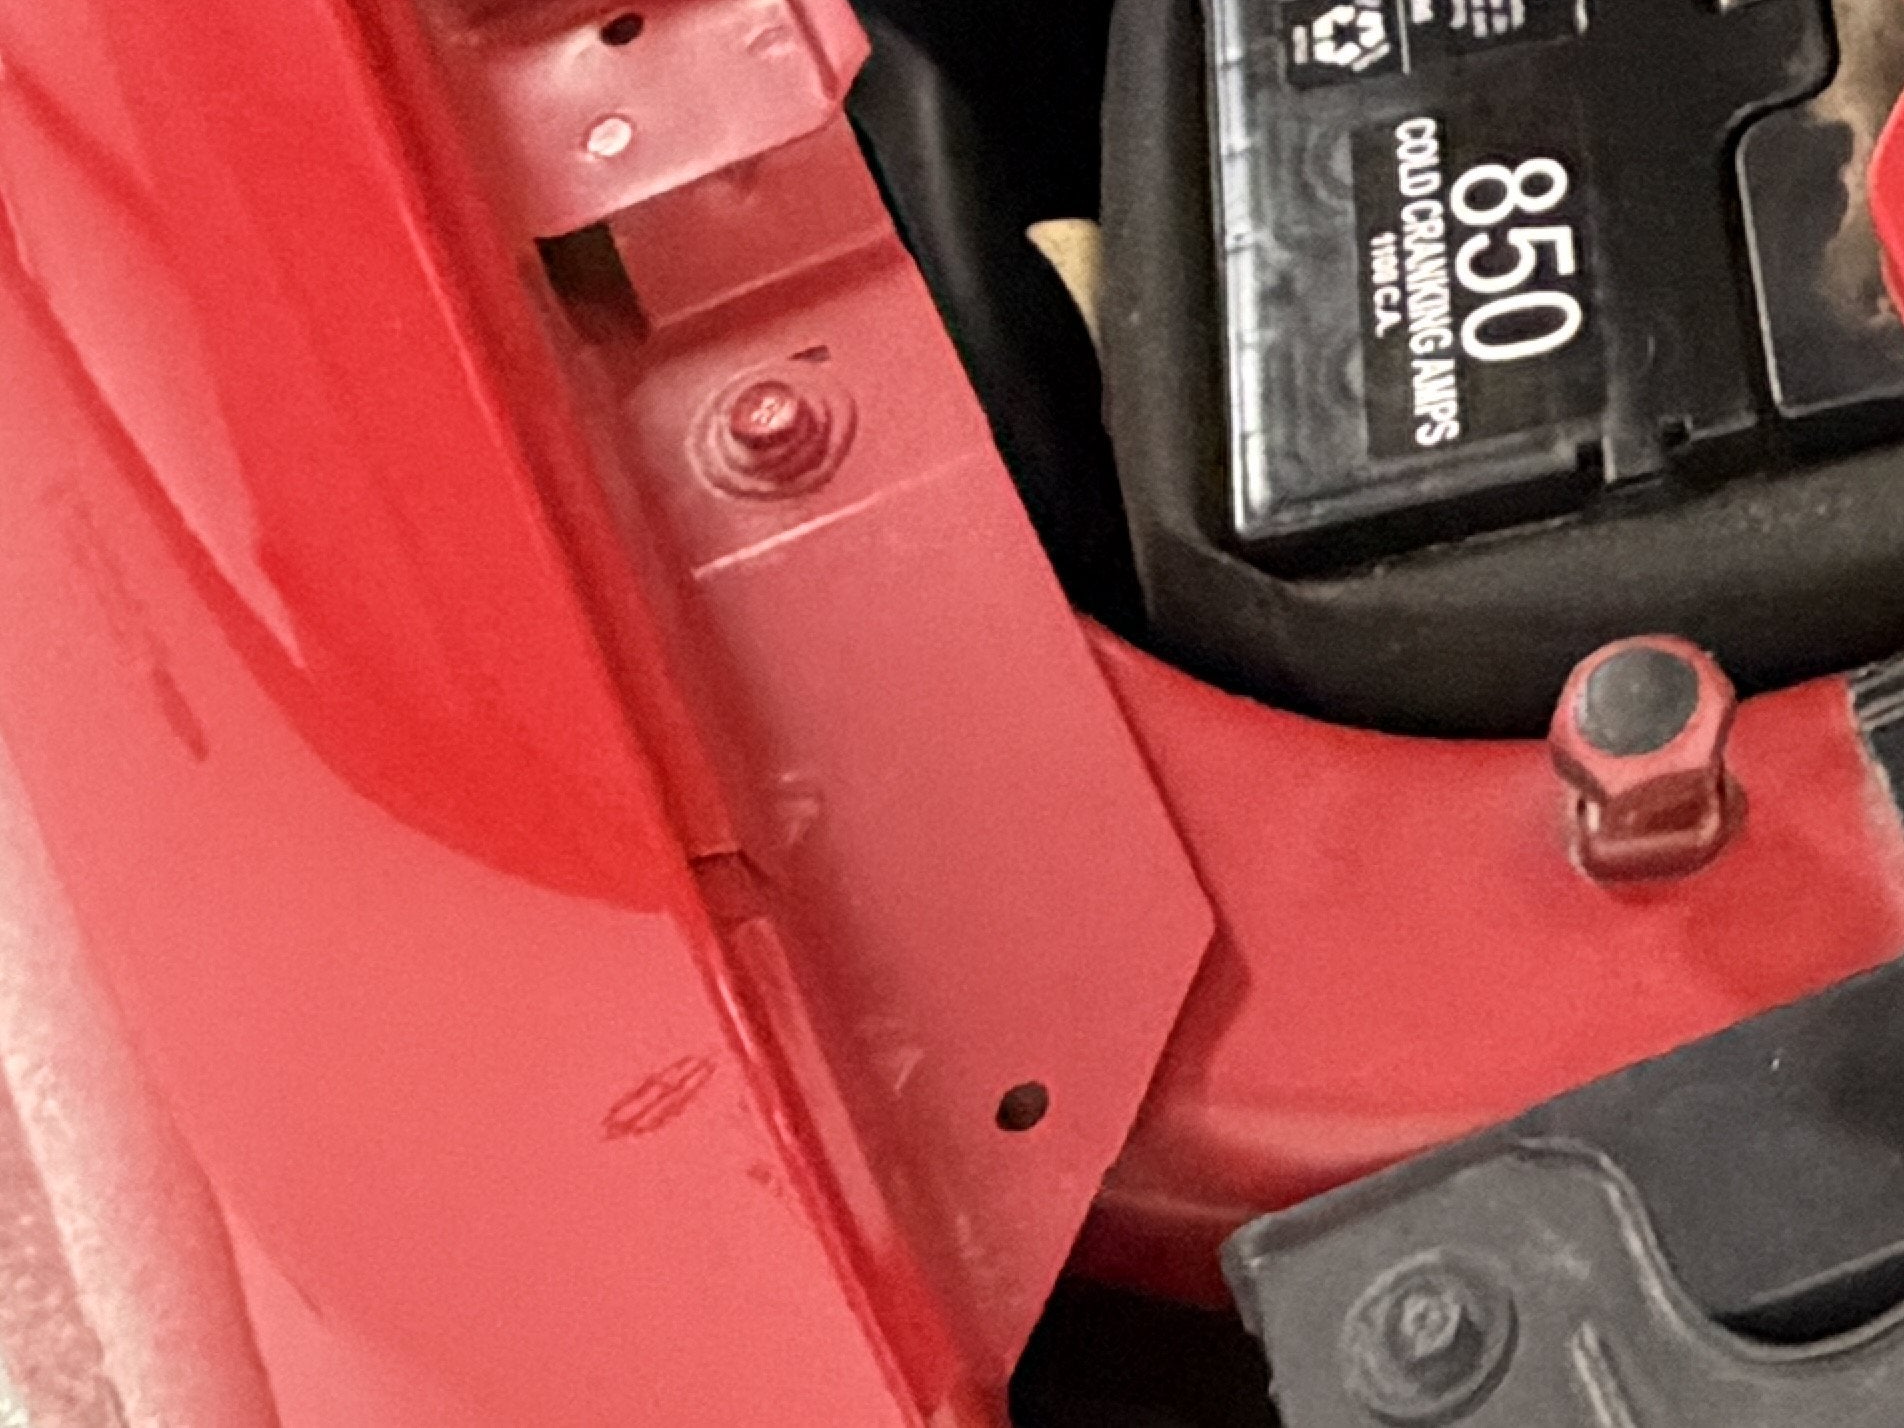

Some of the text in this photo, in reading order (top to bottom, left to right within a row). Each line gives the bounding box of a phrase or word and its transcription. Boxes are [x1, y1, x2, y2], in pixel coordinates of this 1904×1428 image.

[1395, 116, 1460, 446] COLD CRANKING AMPS
[1450, 157, 1583, 361] 850
